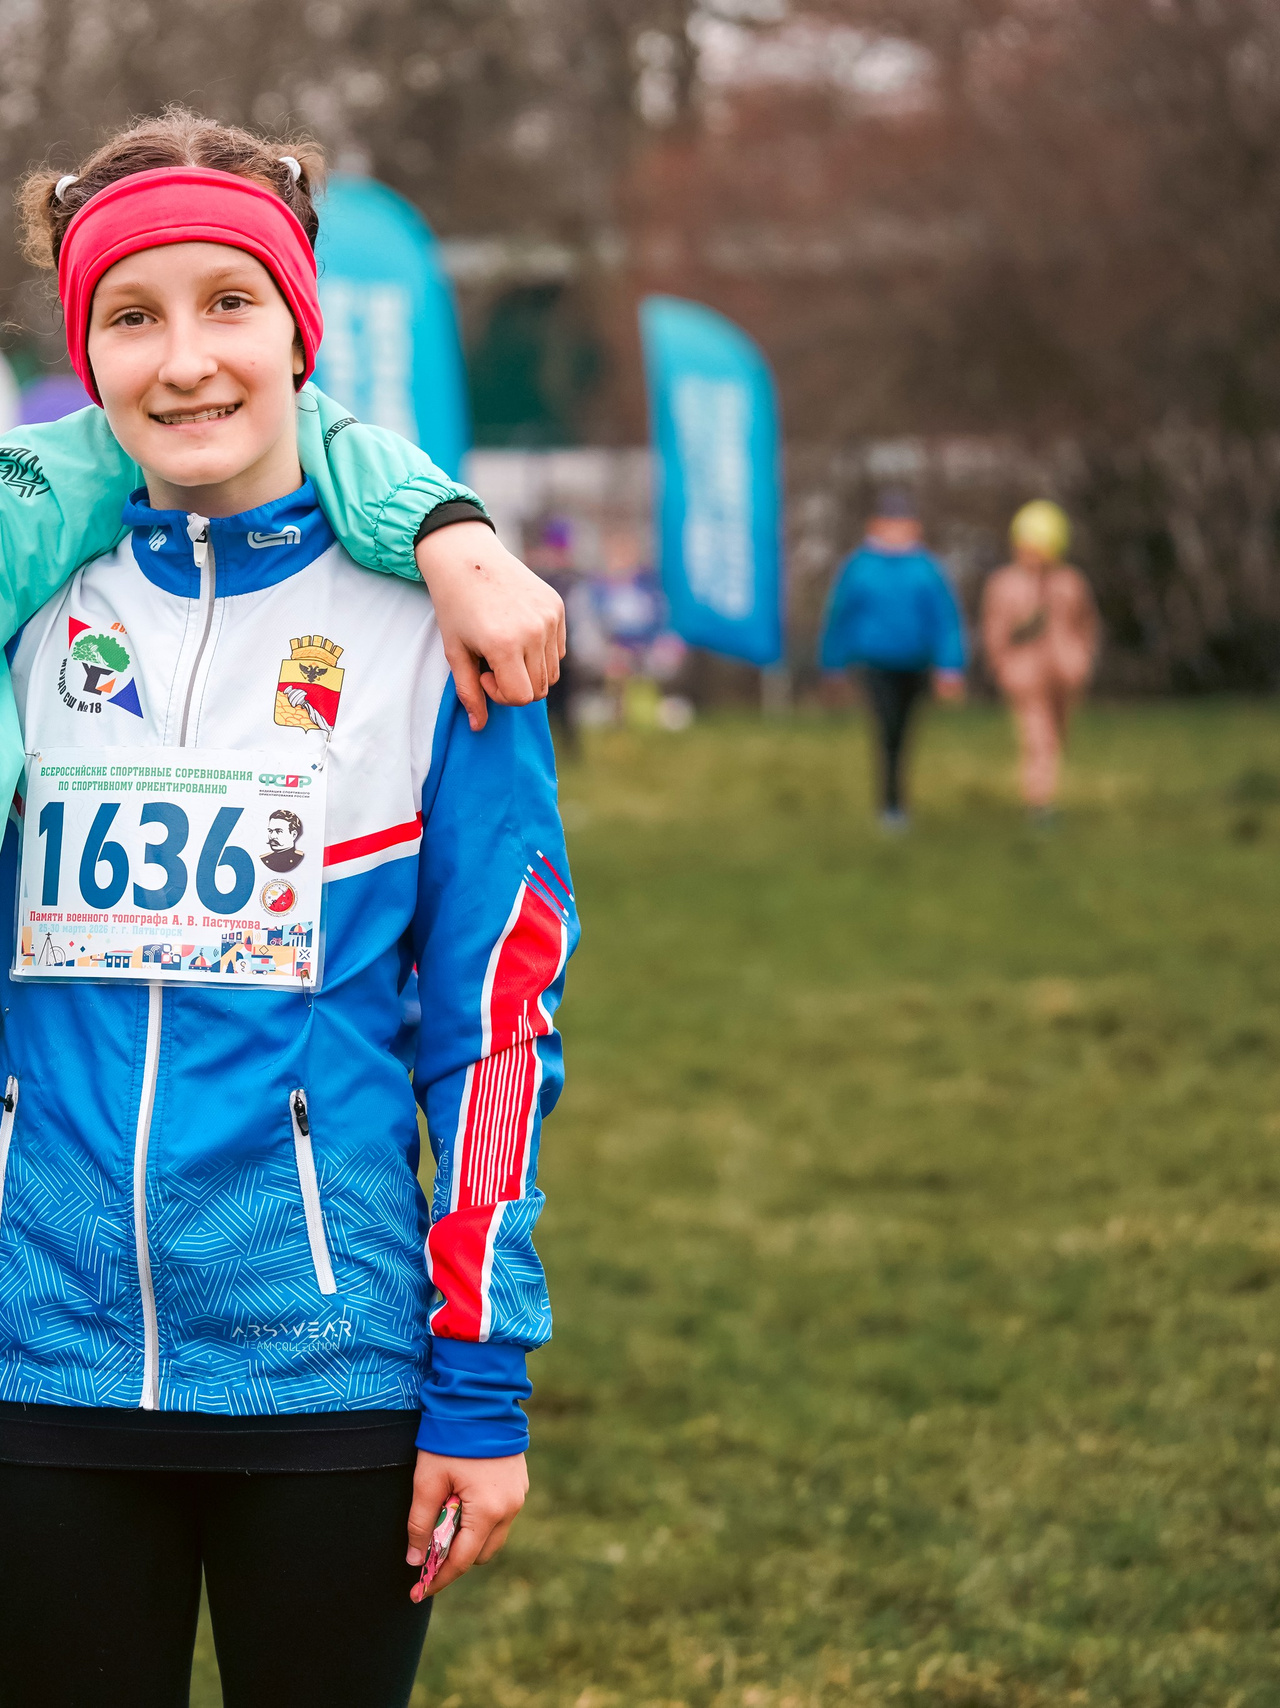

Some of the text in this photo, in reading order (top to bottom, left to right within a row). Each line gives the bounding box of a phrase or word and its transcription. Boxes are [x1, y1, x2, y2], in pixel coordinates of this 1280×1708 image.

[63, 692, 77, 708] СШ
[77, 700, 102, 713] №18
[40, 765, 253, 781] ВСЕРОССИЙСКИЕ СПОРТИВНЫЕ СОРЕВНОВАНИЯ
[58, 781, 228, 794] ПО СПОРТИВНОМУ ОРИЕНТИРОВАНИЮ
[38, 801, 256, 914] 1636
[30, 911, 260, 931] Памяти военного топографа А. В. Пастухова
[62, 924, 86, 934] марта
[89, 925, 108, 934] 2026
[132, 926, 183, 938] Пятигорск
[232, 1320, 352, 1338] ARSWEAR
[244, 1341, 340, 1351] TEAM COLLECTION
